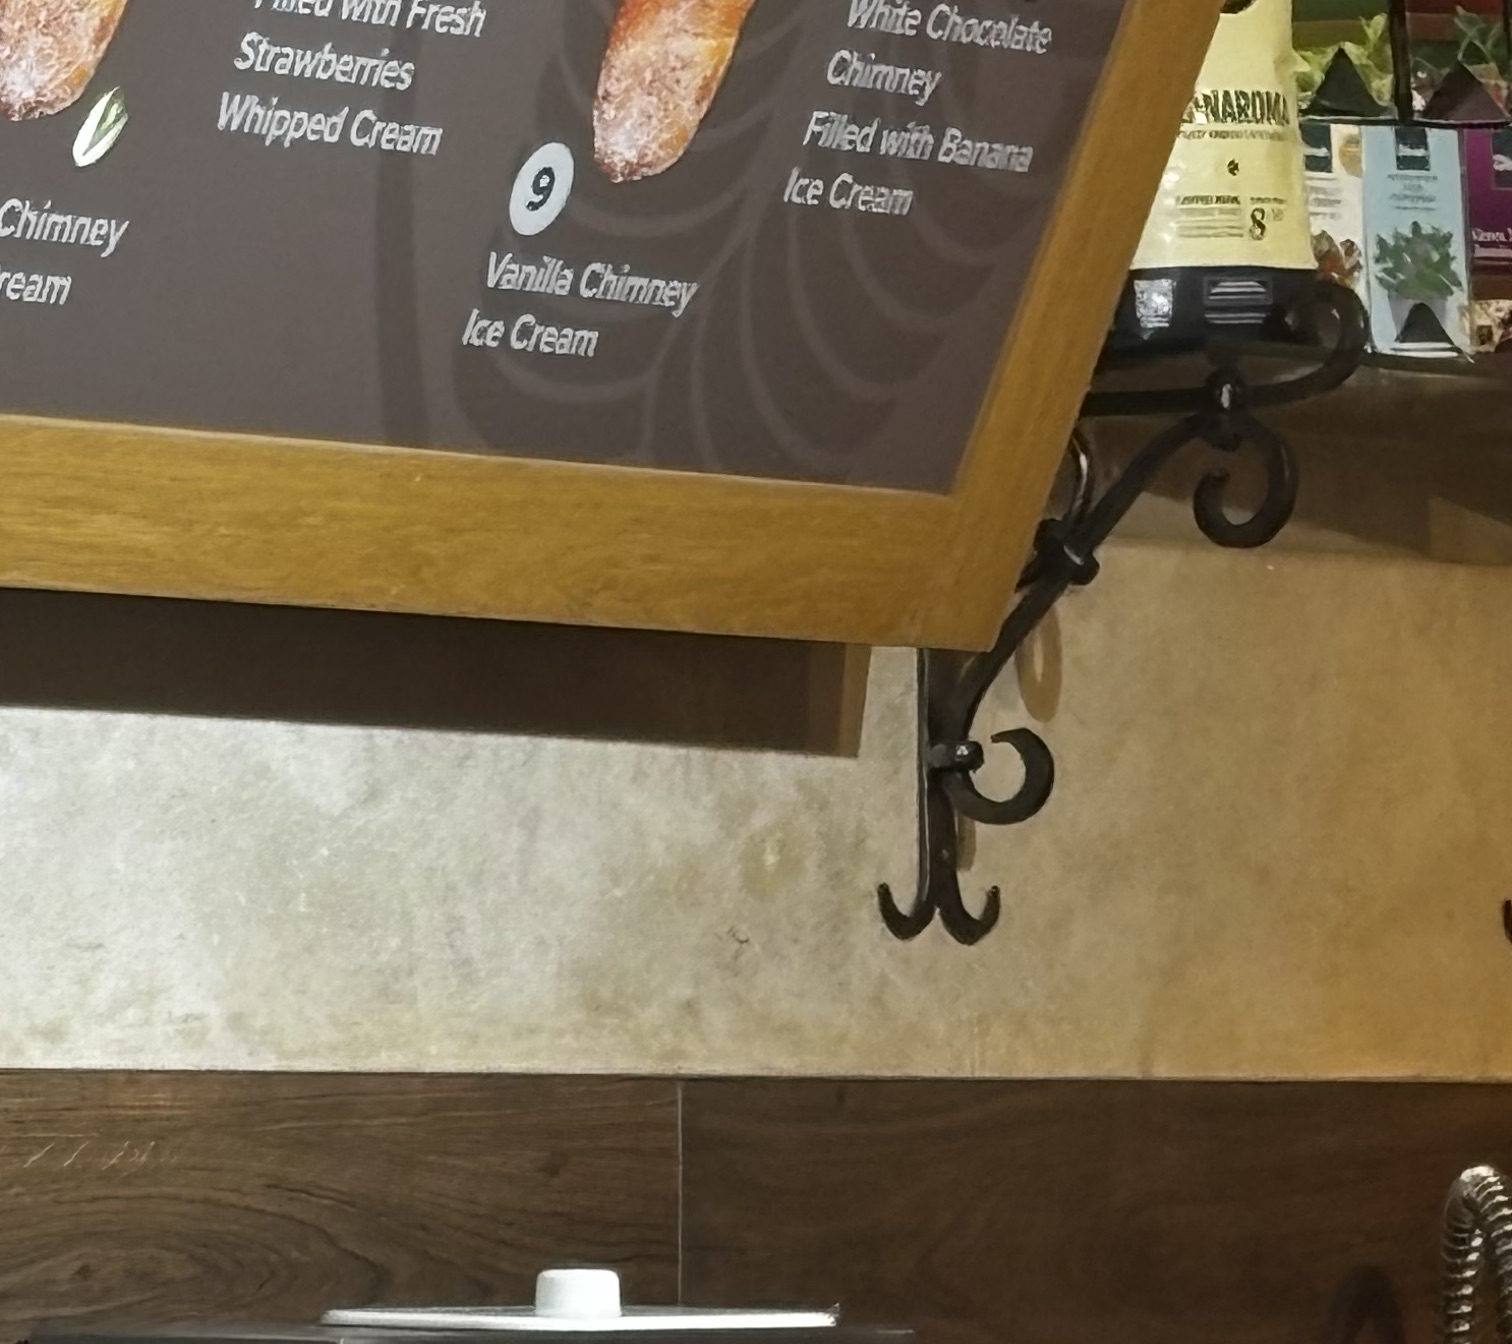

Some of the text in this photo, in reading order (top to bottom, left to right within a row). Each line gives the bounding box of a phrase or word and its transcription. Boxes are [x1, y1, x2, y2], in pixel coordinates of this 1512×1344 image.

[405, 0, 486, 38] Fresh
[234, 31, 416, 92] Strawberries
[826, 50, 942, 105] Chimney
[217, 92, 444, 157] Whipped Cream
[802, 110, 1035, 173] Filled with Banana
[526, 165, 557, 212] 9
[783, 166, 913, 216] Ice Cream
[486, 251, 699, 318] Vanilla Chimney
[462, 308, 599, 358] Ice Cream
